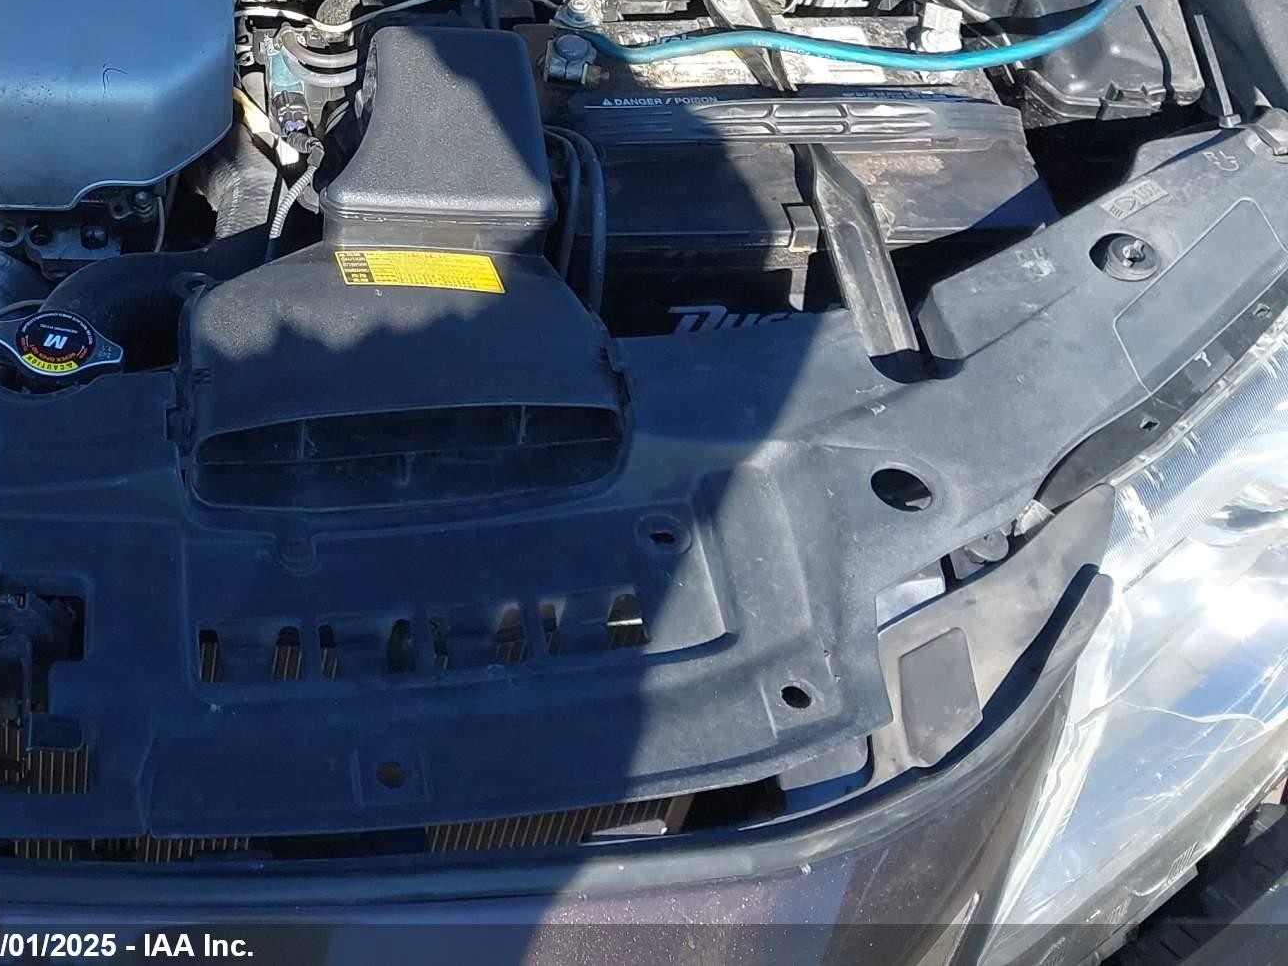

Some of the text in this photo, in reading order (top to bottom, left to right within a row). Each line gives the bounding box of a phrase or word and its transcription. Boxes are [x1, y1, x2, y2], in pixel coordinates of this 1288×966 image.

[614, 97, 663, 107] DANGER
[674, 96, 718, 106] POISON
[42, 333, 69, 350] M
[26, 355, 66, 371] CAUTION
